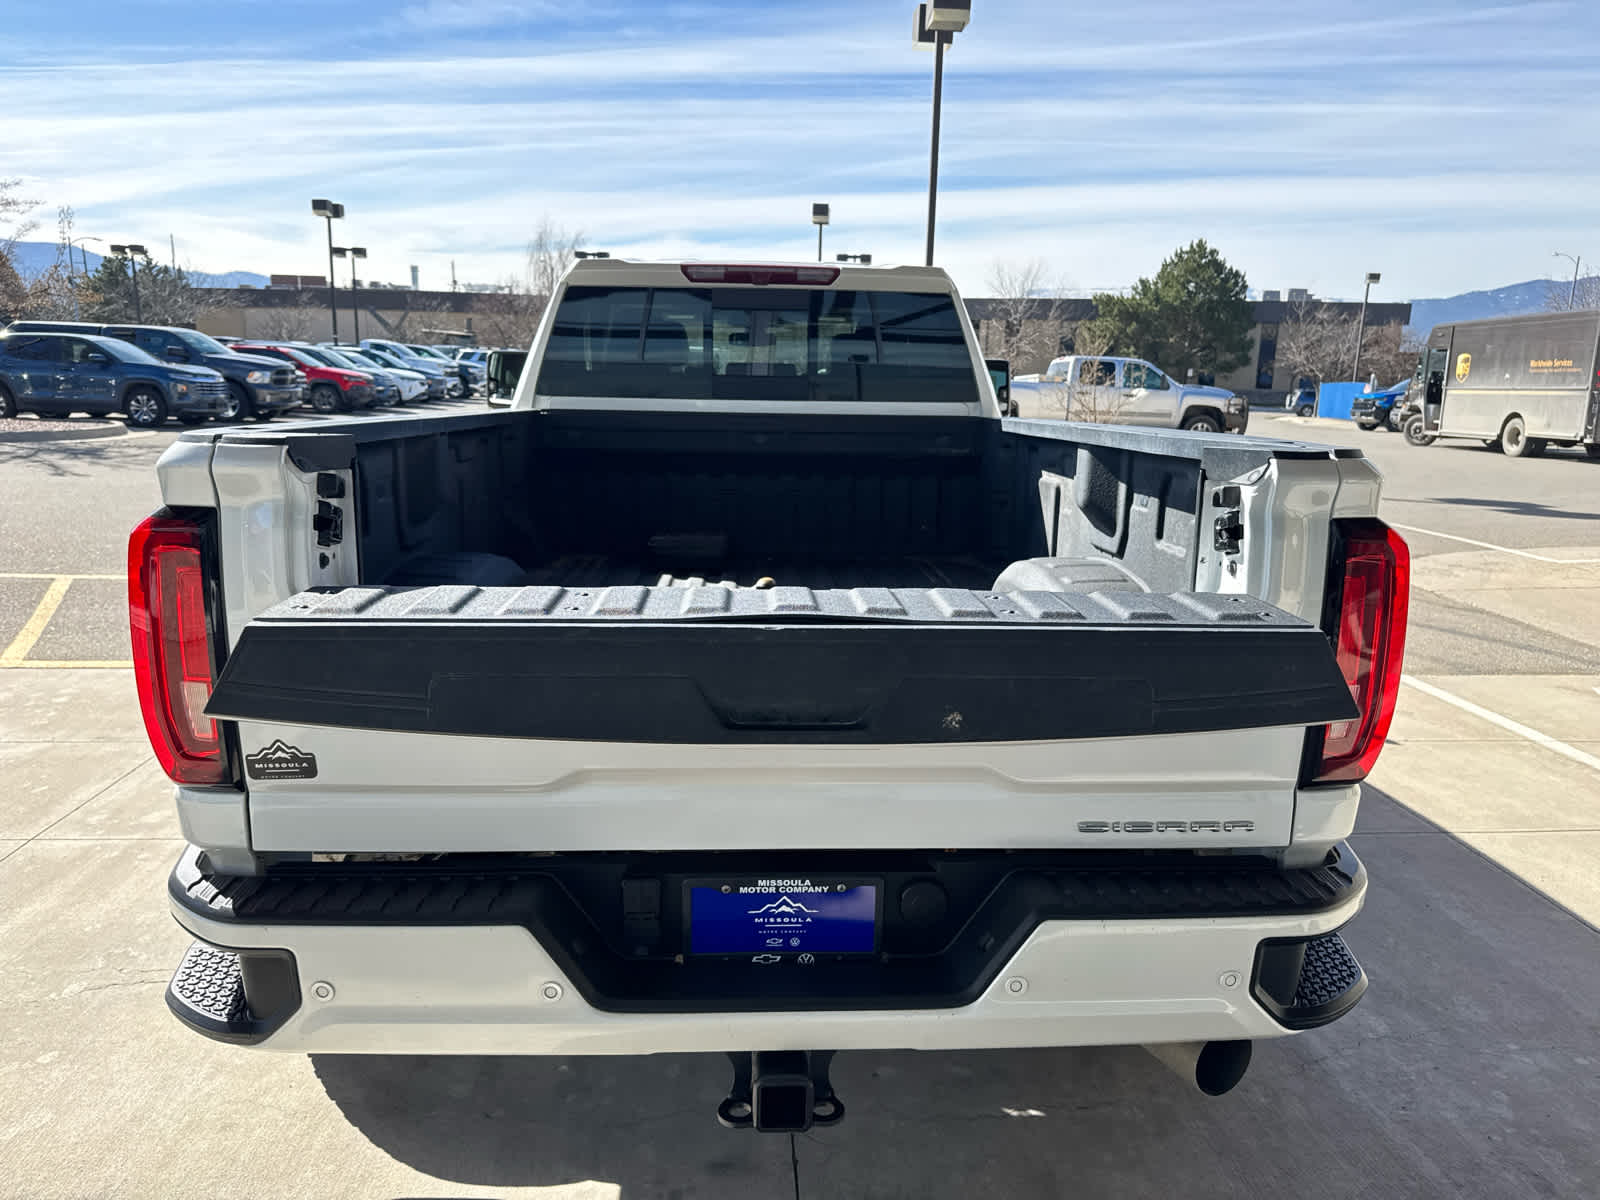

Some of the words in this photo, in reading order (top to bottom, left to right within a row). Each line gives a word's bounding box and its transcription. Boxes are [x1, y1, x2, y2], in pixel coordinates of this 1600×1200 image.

[1078, 820, 1256, 833] SIERRA
[757, 879, 811, 887] MISSOULA
[739, 886, 776, 894] MOTOR
